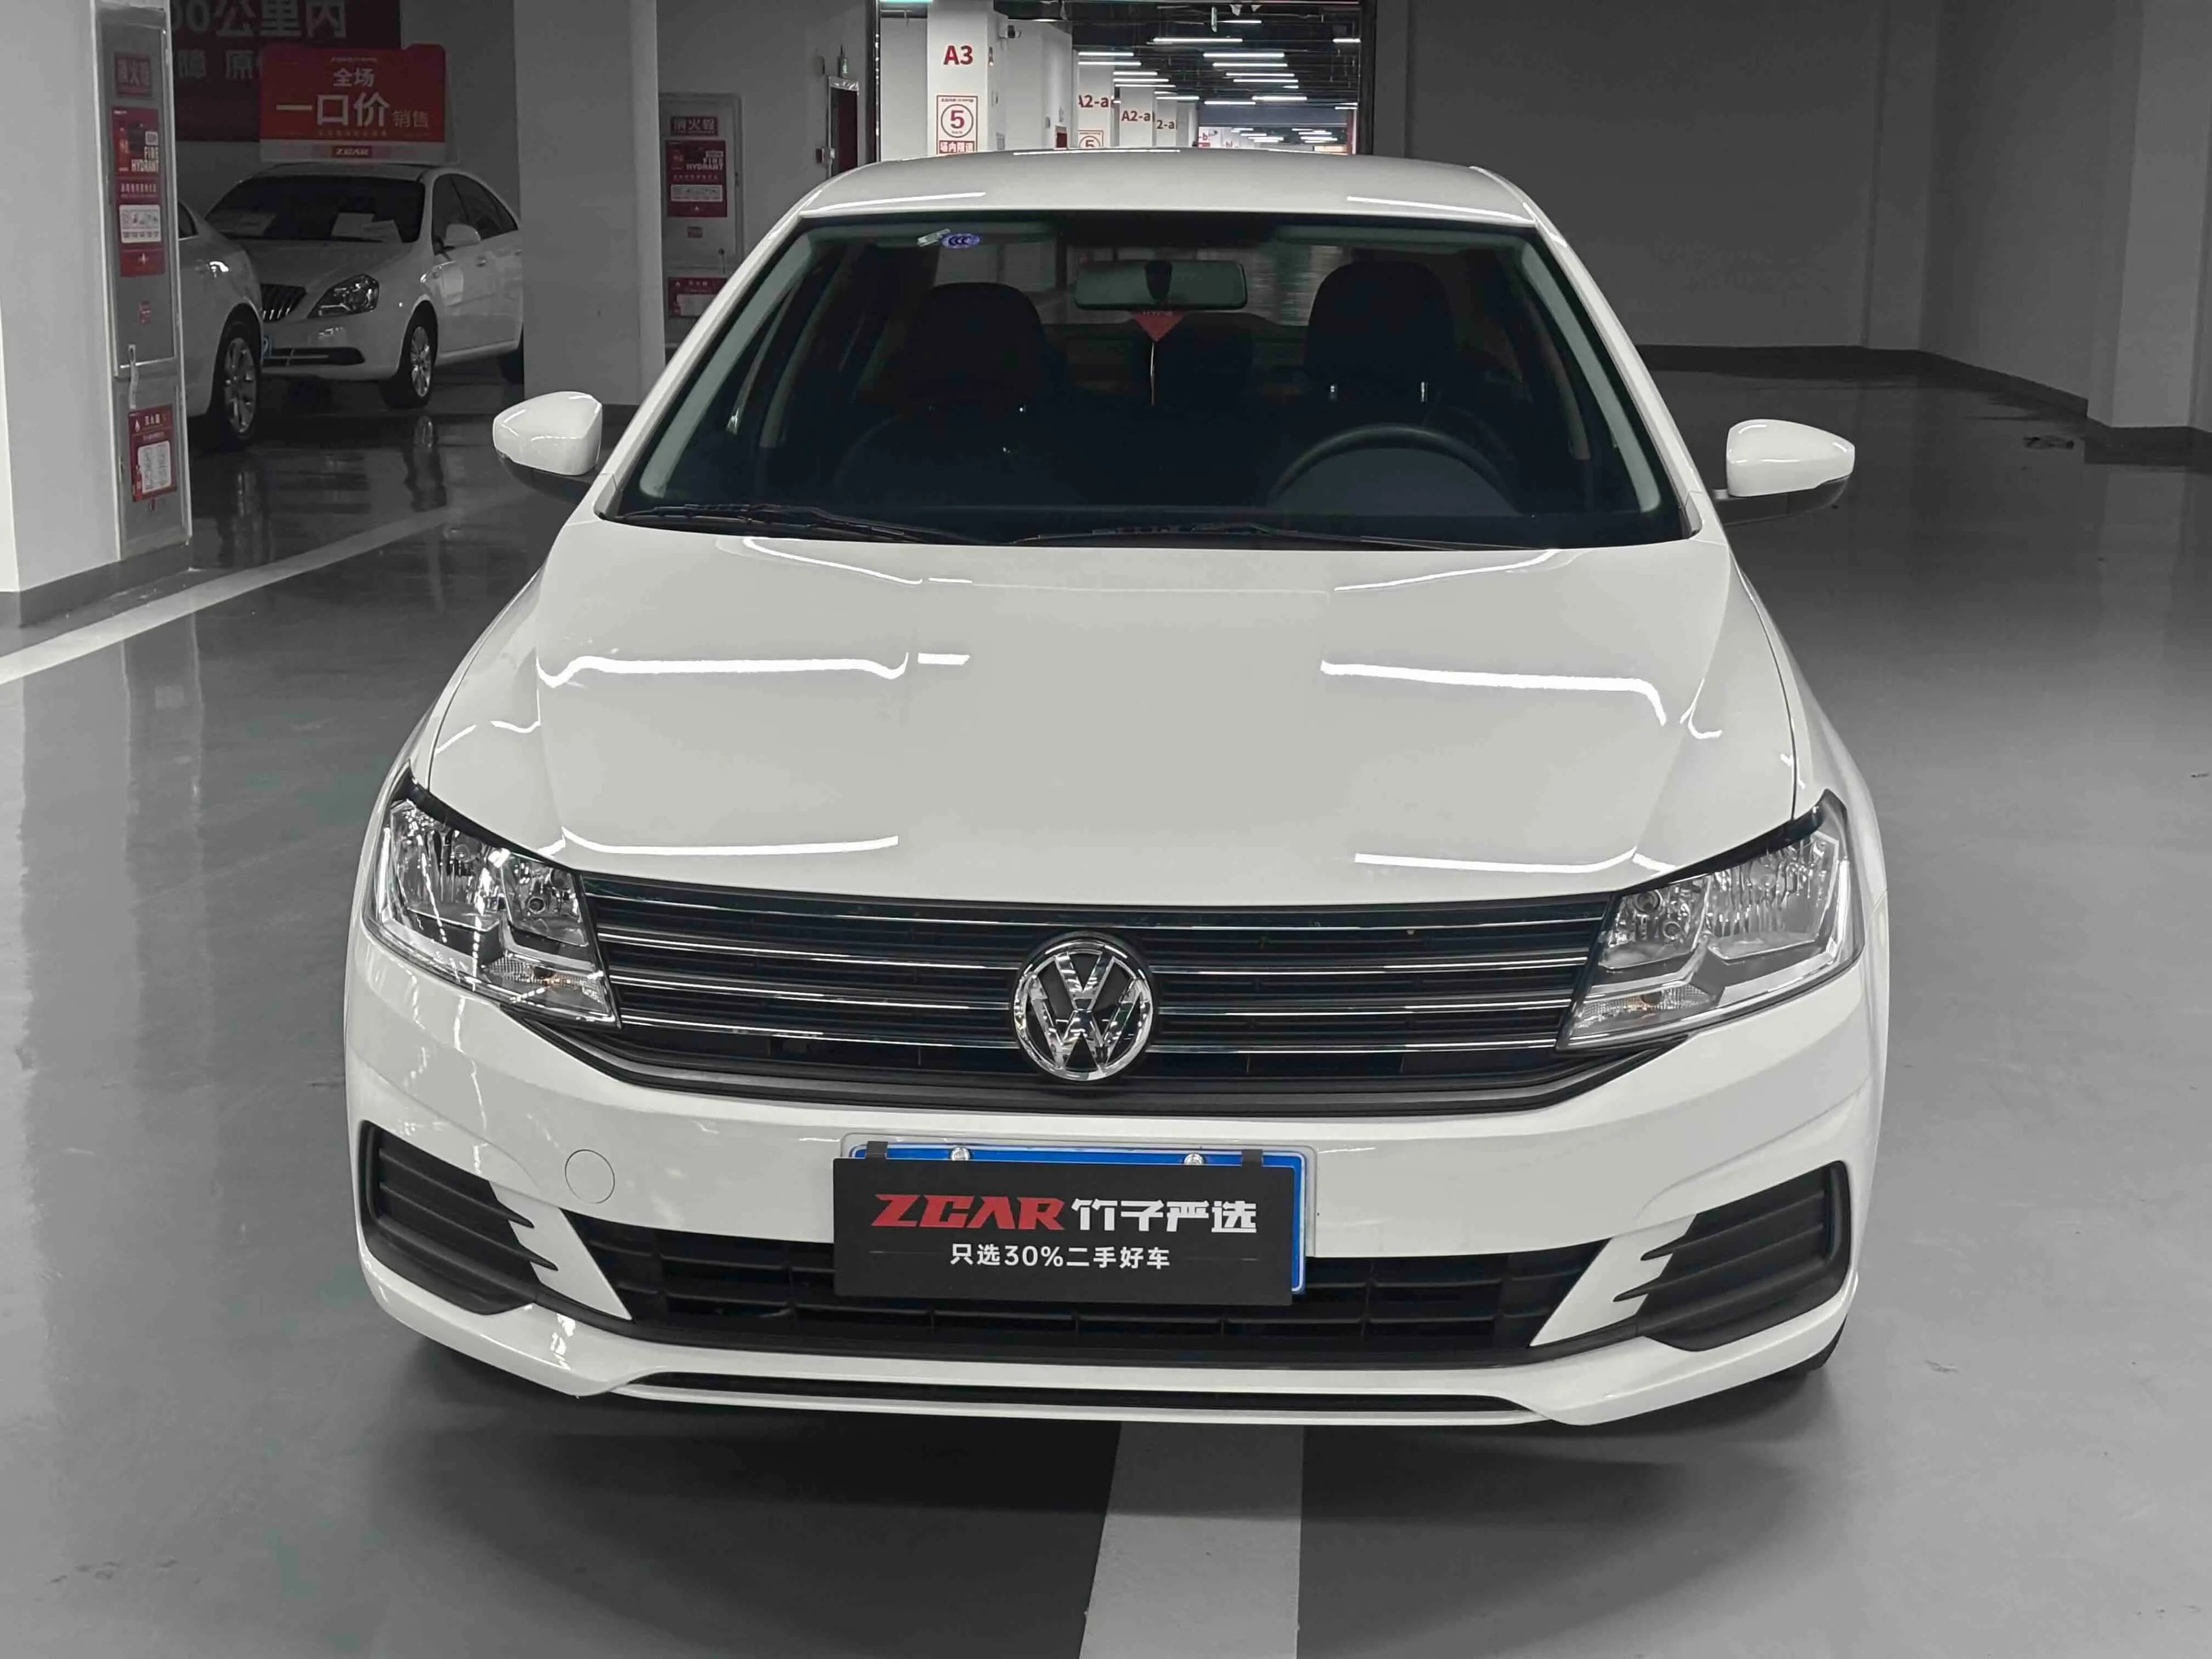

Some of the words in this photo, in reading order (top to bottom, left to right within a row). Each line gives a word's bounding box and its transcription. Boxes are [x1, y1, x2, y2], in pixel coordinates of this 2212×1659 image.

[943, 45, 974, 65] A3
[333, 67, 374, 87] 全场
[276, 92, 391, 127] 一口价
[392, 109, 429, 128] 销售
[950, 109, 965, 129] 5
[870, 1194, 1065, 1230] ZCAR
[1071, 1198, 1257, 1233] 竹子严选
[950, 1243, 1171, 1270] 只选30%二手好车
